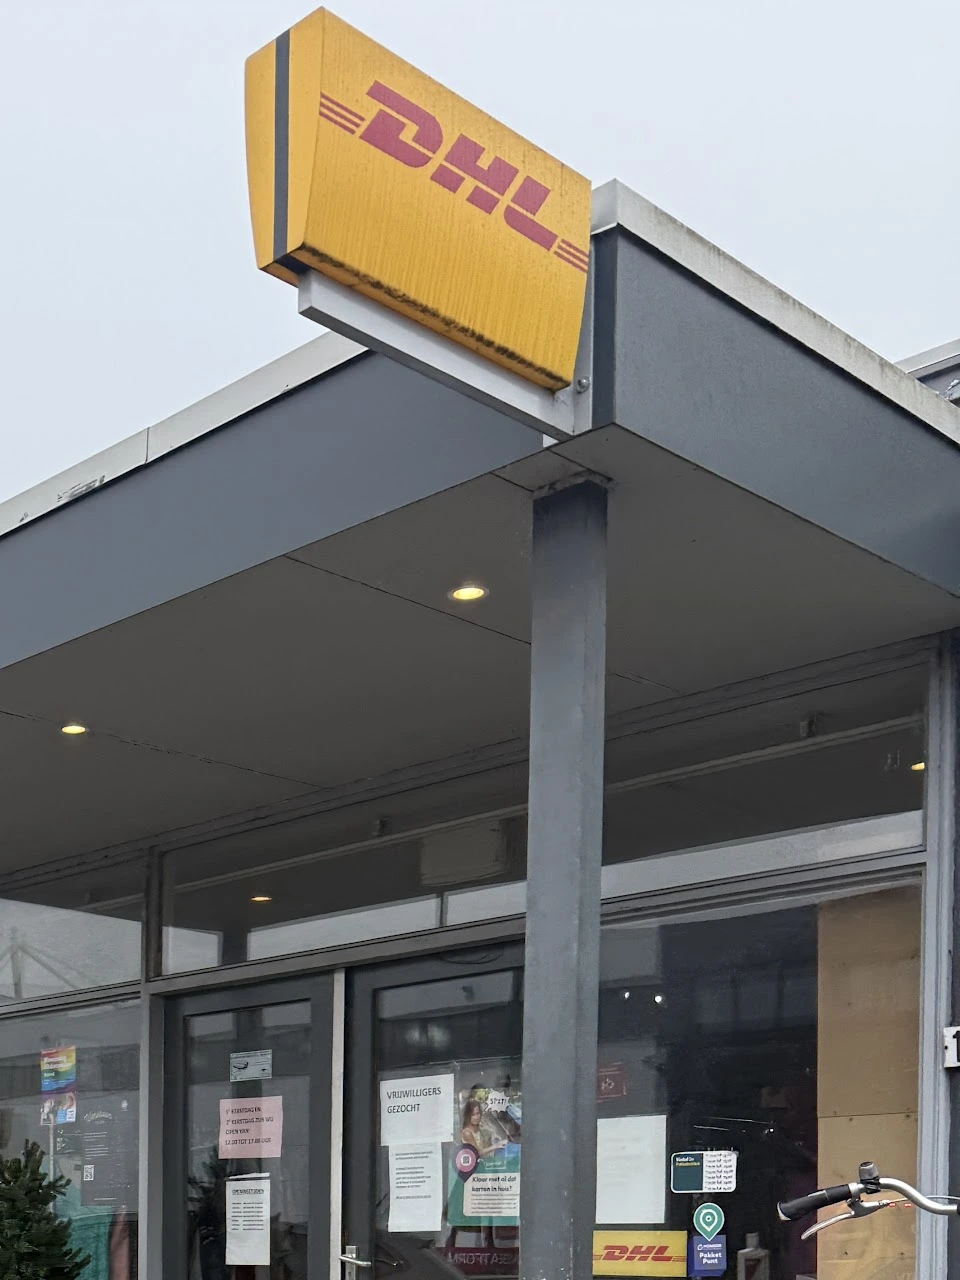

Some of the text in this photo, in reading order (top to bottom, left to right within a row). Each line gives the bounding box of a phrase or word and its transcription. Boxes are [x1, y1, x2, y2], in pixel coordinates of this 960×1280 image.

[359, 80, 559, 250] DHL
[387, 1087, 442, 1100] VRIJWILLIGERS
[387, 1103, 421, 1114] GEZOCHT
[602, 1245, 673, 1261] DHL
[699, 1251, 722, 1259] Pakket
